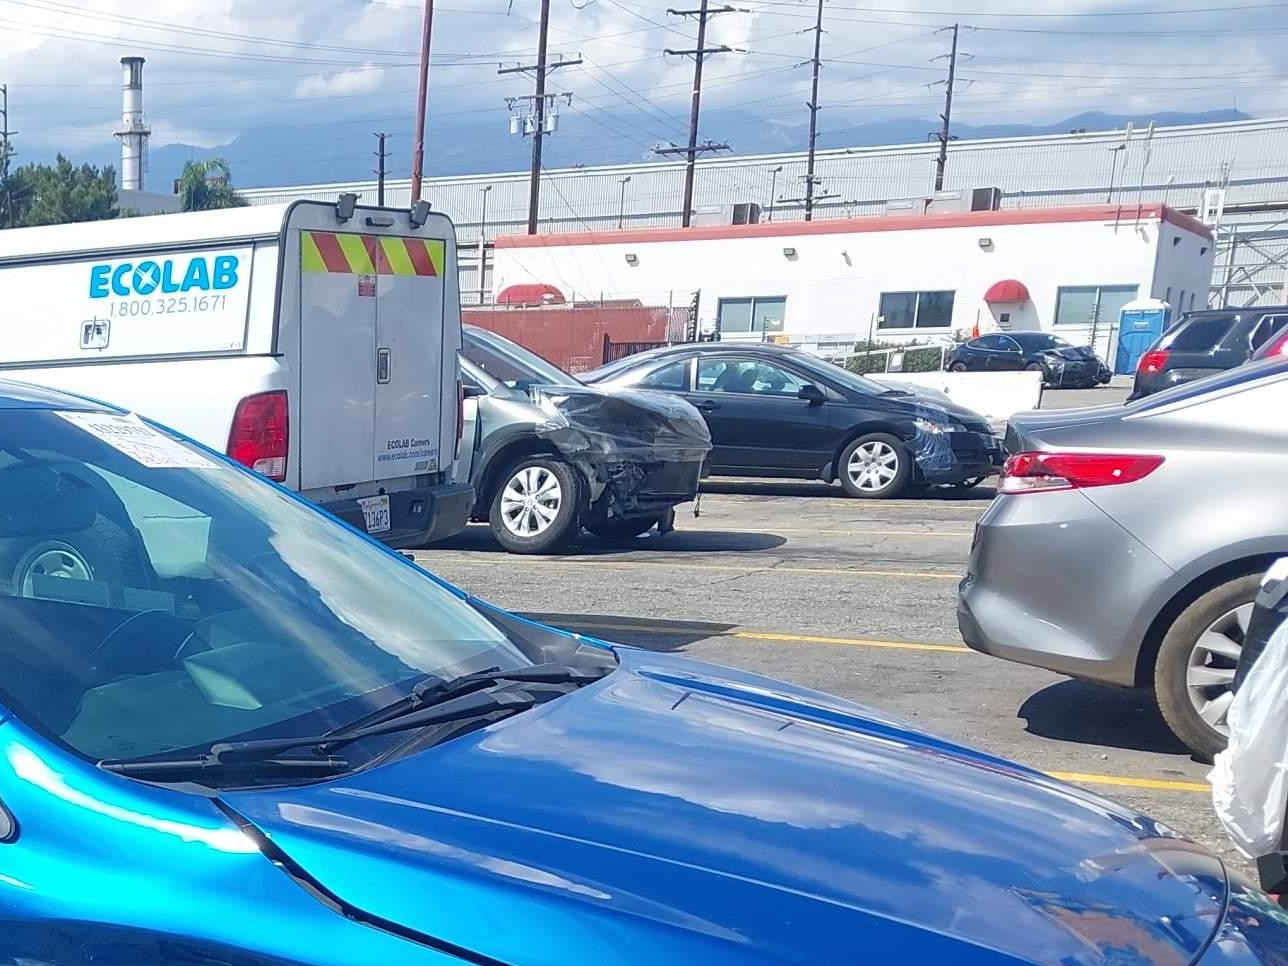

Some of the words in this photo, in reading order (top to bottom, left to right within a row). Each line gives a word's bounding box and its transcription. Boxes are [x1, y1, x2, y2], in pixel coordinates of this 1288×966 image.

[89, 255, 239, 299] ECOLAB
[110, 294, 226, 317] 1.800.325.1671
[387, 440, 410, 450] ECOLAB
